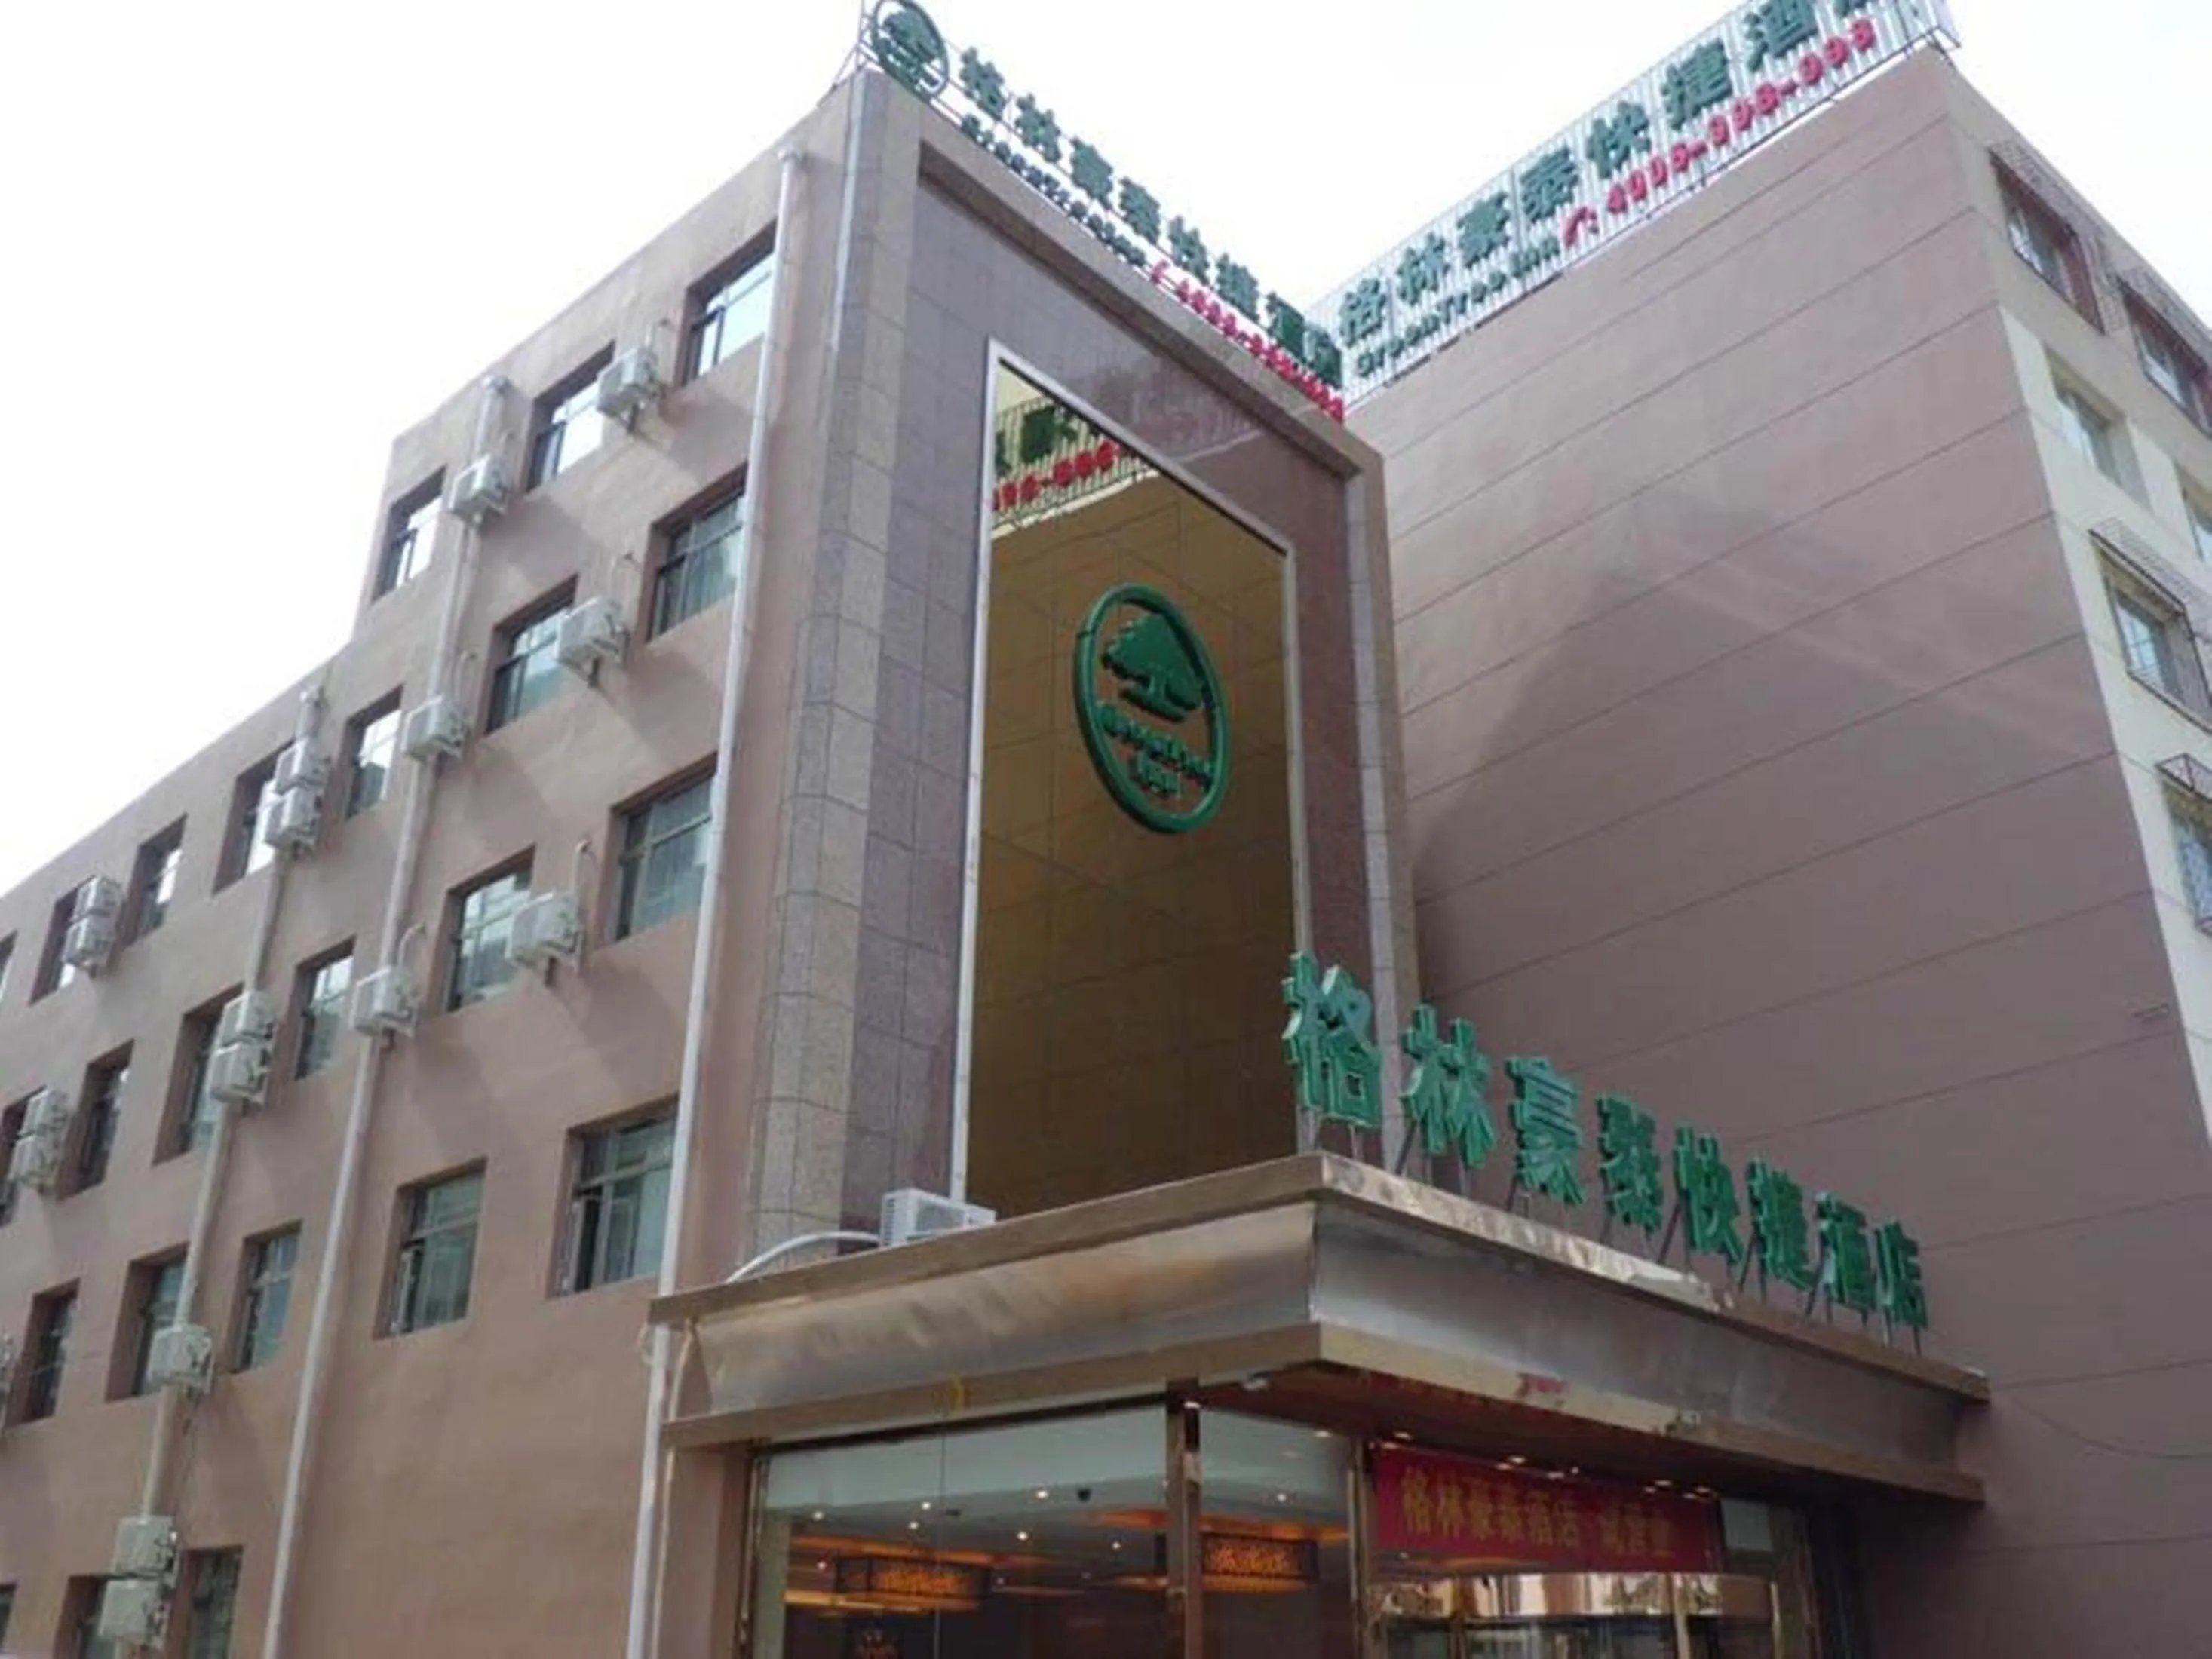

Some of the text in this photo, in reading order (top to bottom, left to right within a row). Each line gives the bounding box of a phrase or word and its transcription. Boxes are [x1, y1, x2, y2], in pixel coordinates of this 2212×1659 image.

[1338, 0, 1872, 347] 格林豪泰快捷酒
[1281, 949, 1928, 1329] 格林豪泰快捷酒店
